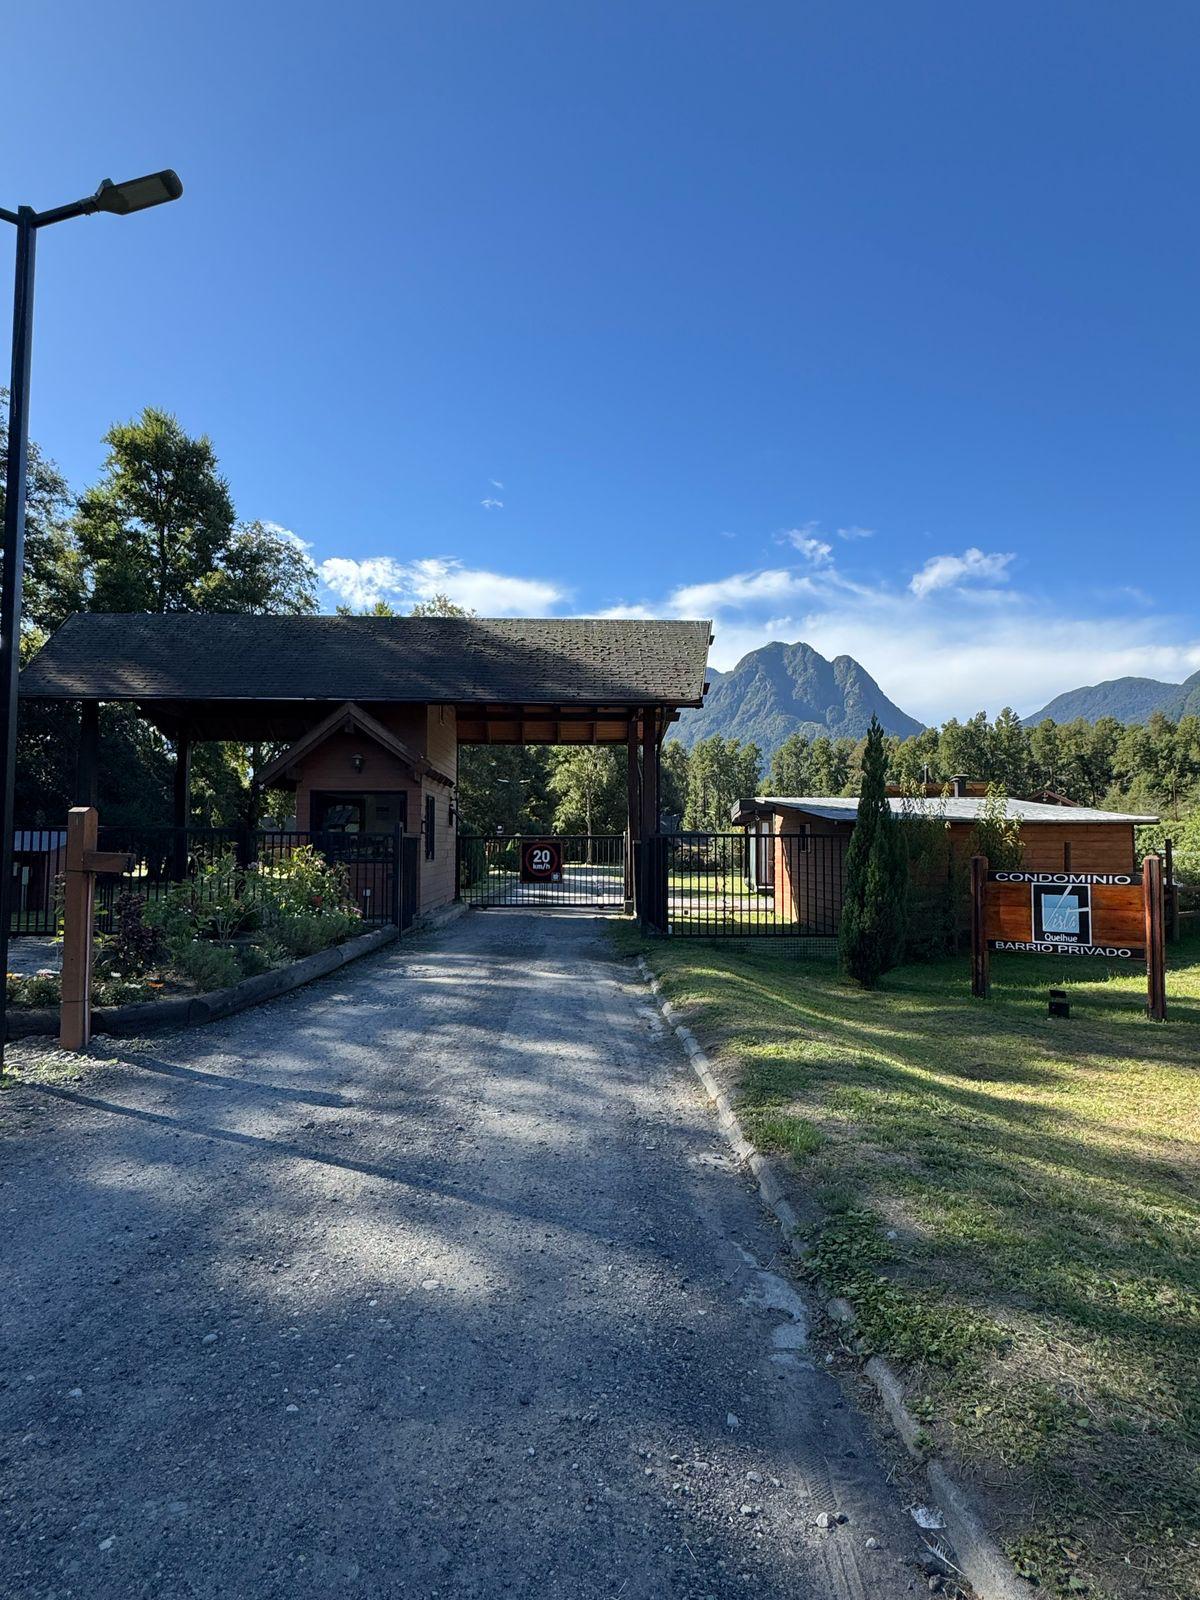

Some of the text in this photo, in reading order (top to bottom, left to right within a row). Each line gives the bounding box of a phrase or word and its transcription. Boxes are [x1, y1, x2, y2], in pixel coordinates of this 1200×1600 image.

[533, 850, 550, 863] 20
[995, 872, 1131, 885] CONDOMINIO
[1044, 933, 1078, 943] Quelhue
[995, 941, 1131, 958] BARRIO PRIVADO
